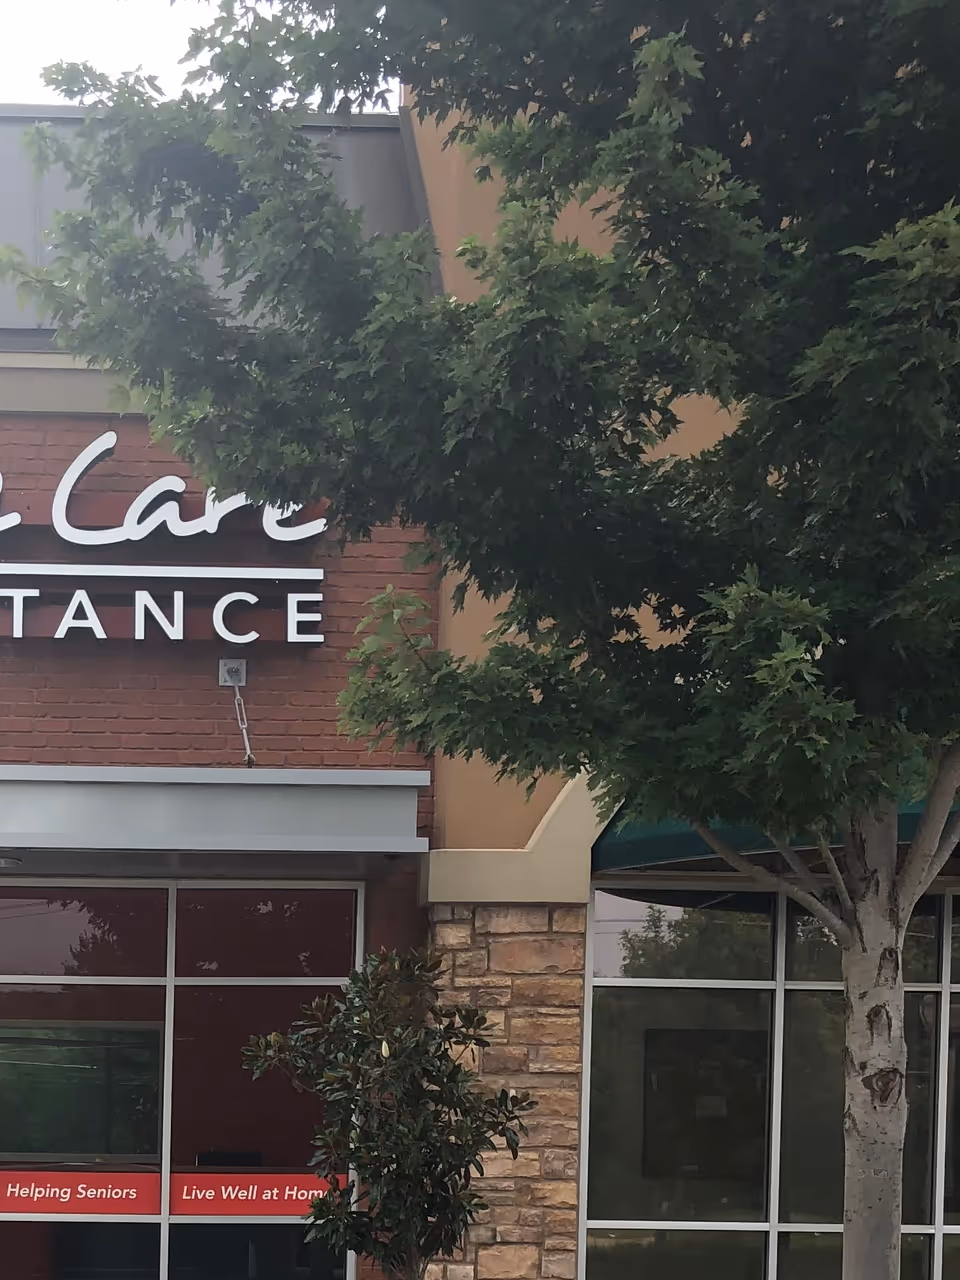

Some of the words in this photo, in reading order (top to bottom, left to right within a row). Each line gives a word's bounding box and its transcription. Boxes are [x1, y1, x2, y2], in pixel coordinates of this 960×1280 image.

[51, 431, 329, 546] Care
[6, 1182, 71, 1202] Helping
[76, 1184, 138, 1200] Seniors
[182, 1185, 216, 1200] Live
[221, 1185, 258, 1200] Well
[262, 1187, 280, 1200] at
[284, 1186, 328, 1200] Hom
